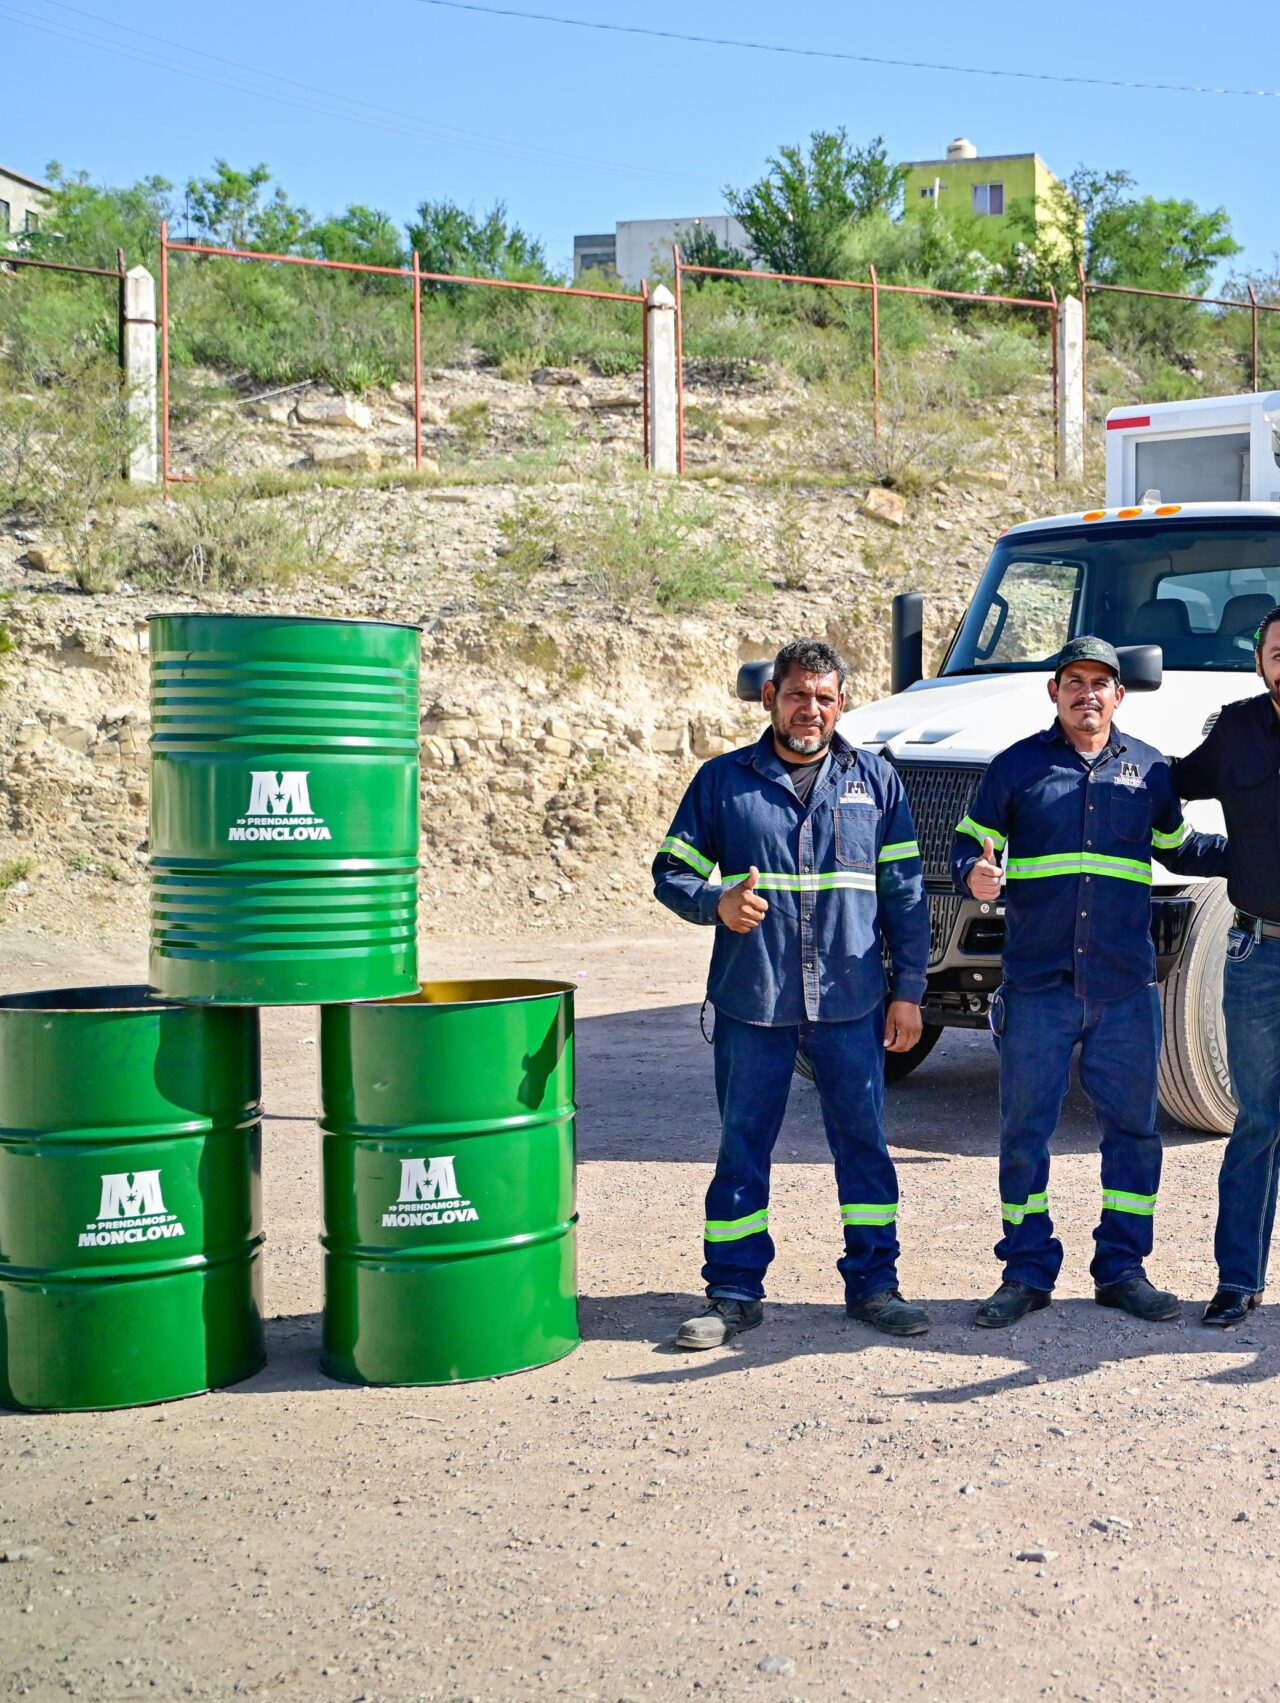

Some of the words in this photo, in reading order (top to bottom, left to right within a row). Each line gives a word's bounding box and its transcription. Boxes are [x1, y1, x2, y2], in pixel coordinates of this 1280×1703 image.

[247, 817, 312, 825] PRENDAMOS
[228, 826, 332, 841] MONCLOVA
[398, 1200, 460, 1212] PRENDAMOS
[98, 1215, 166, 1230] PRENDAMOS
[382, 1208, 479, 1227] MONCLOVA
[78, 1222, 185, 1247] MONCLOVA
